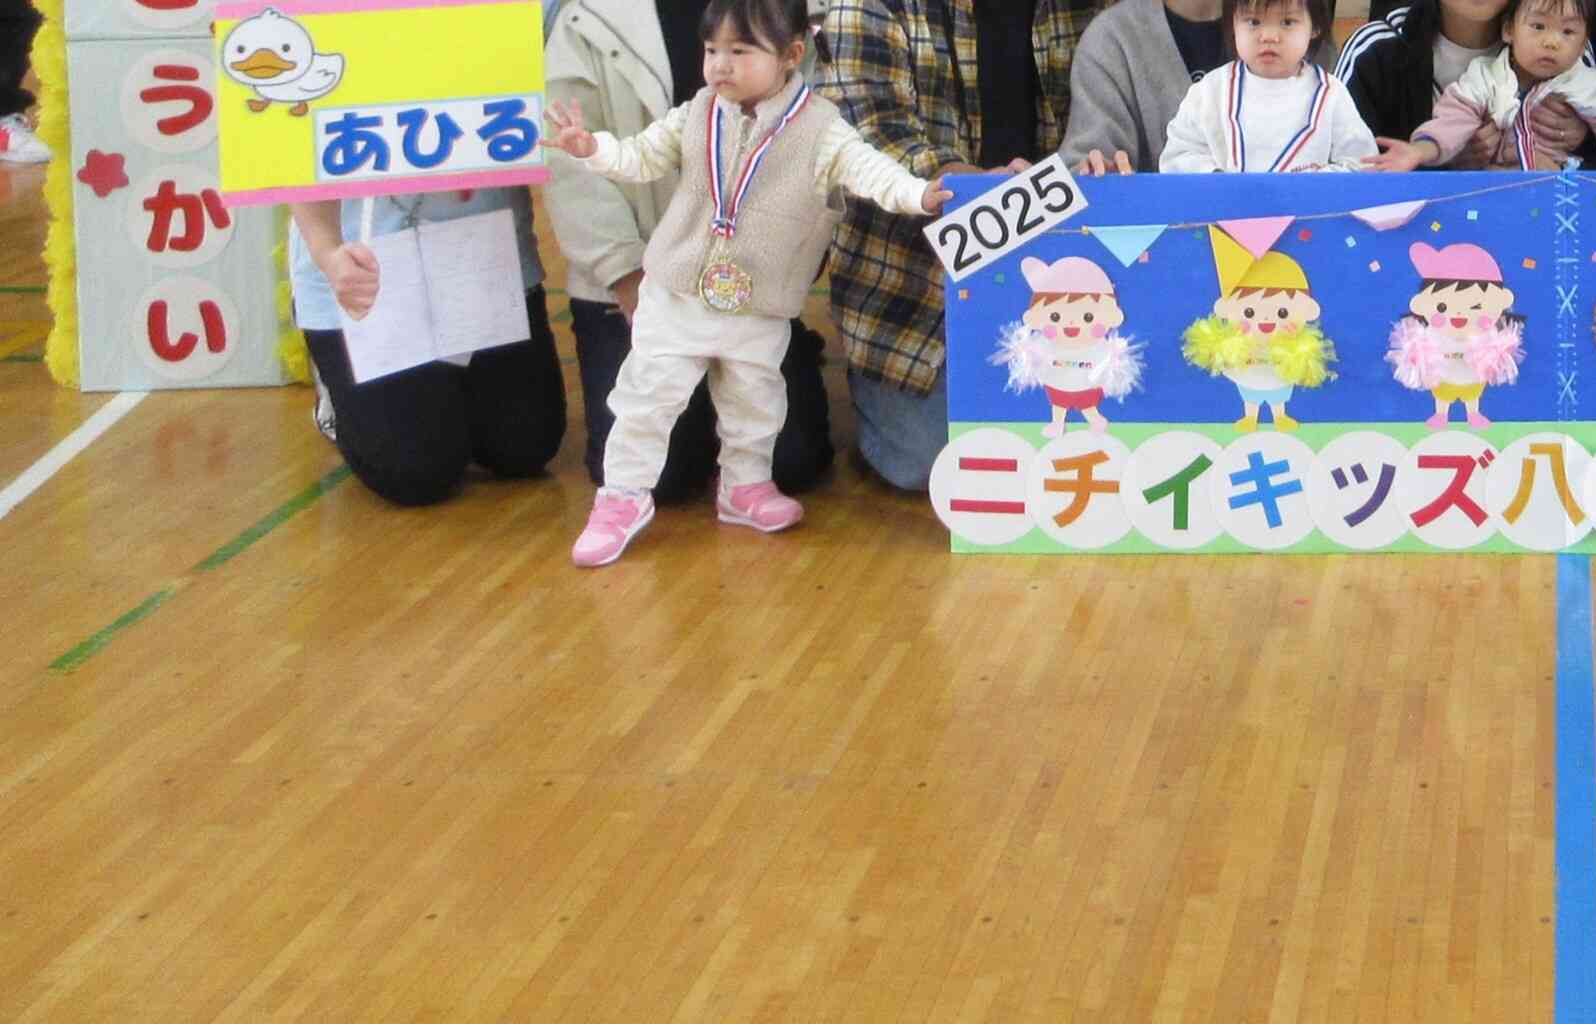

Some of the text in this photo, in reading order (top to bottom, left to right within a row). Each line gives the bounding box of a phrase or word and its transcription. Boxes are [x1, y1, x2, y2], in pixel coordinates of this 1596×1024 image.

[320, 98, 540, 177] あひる
[938, 165, 1075, 272] 2025
